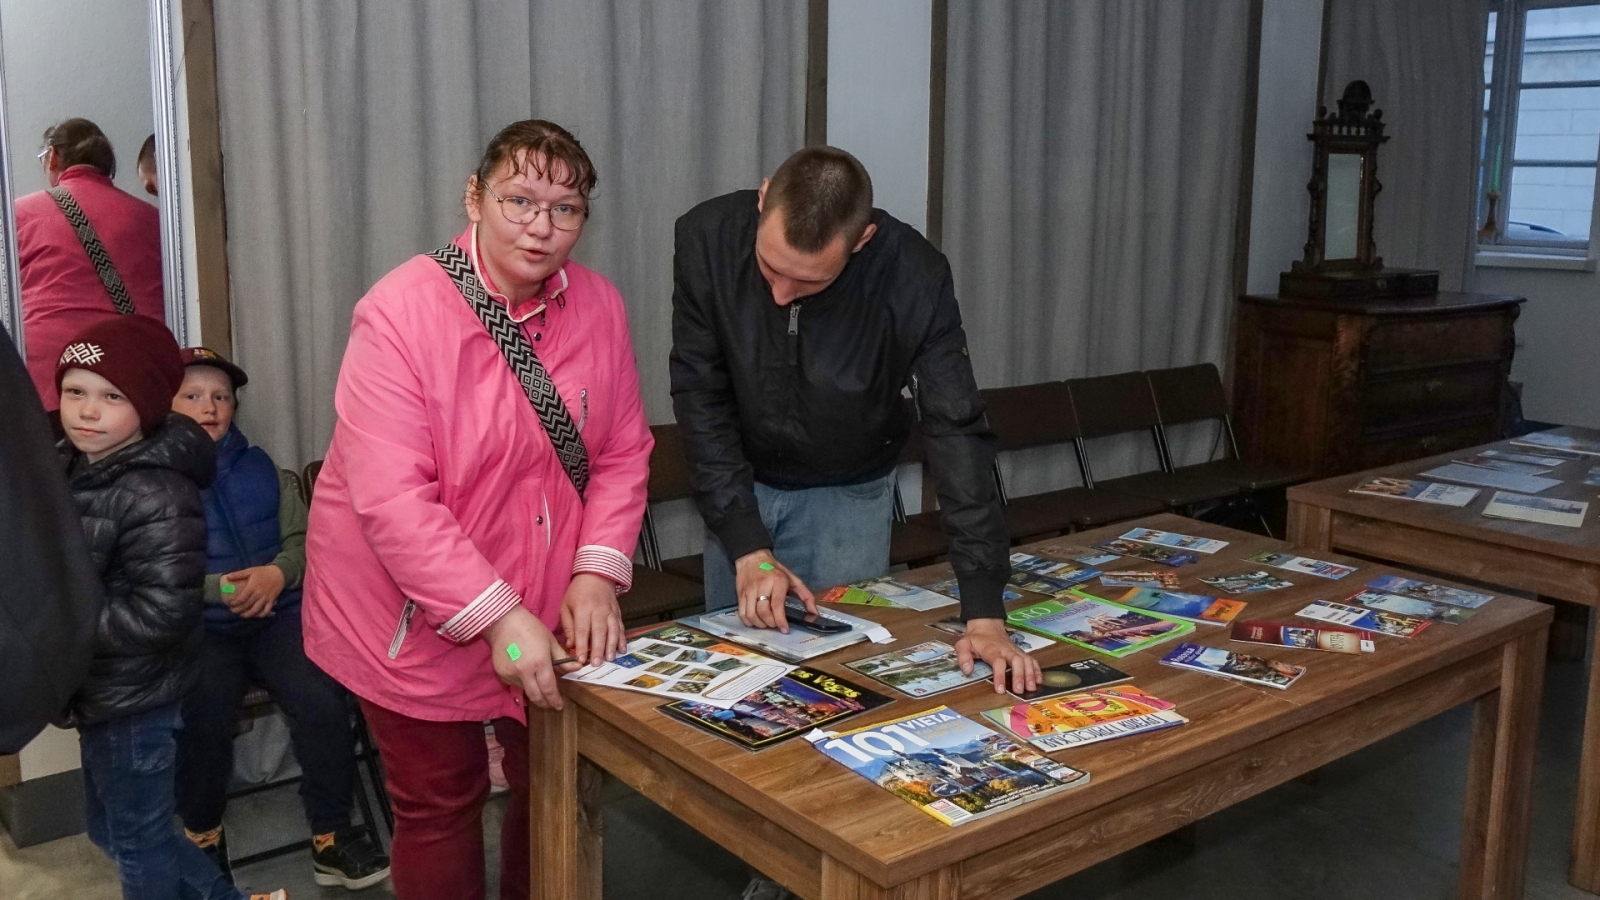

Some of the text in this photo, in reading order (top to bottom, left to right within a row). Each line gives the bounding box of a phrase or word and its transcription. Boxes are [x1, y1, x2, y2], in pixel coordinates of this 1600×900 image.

[1007, 605, 1052, 622] GEO
[1121, 713, 1169, 731] ГРУЗИЯ
[824, 725, 931, 762] 101
[1039, 725, 1118, 748] ТУРИСТСКАЯ
